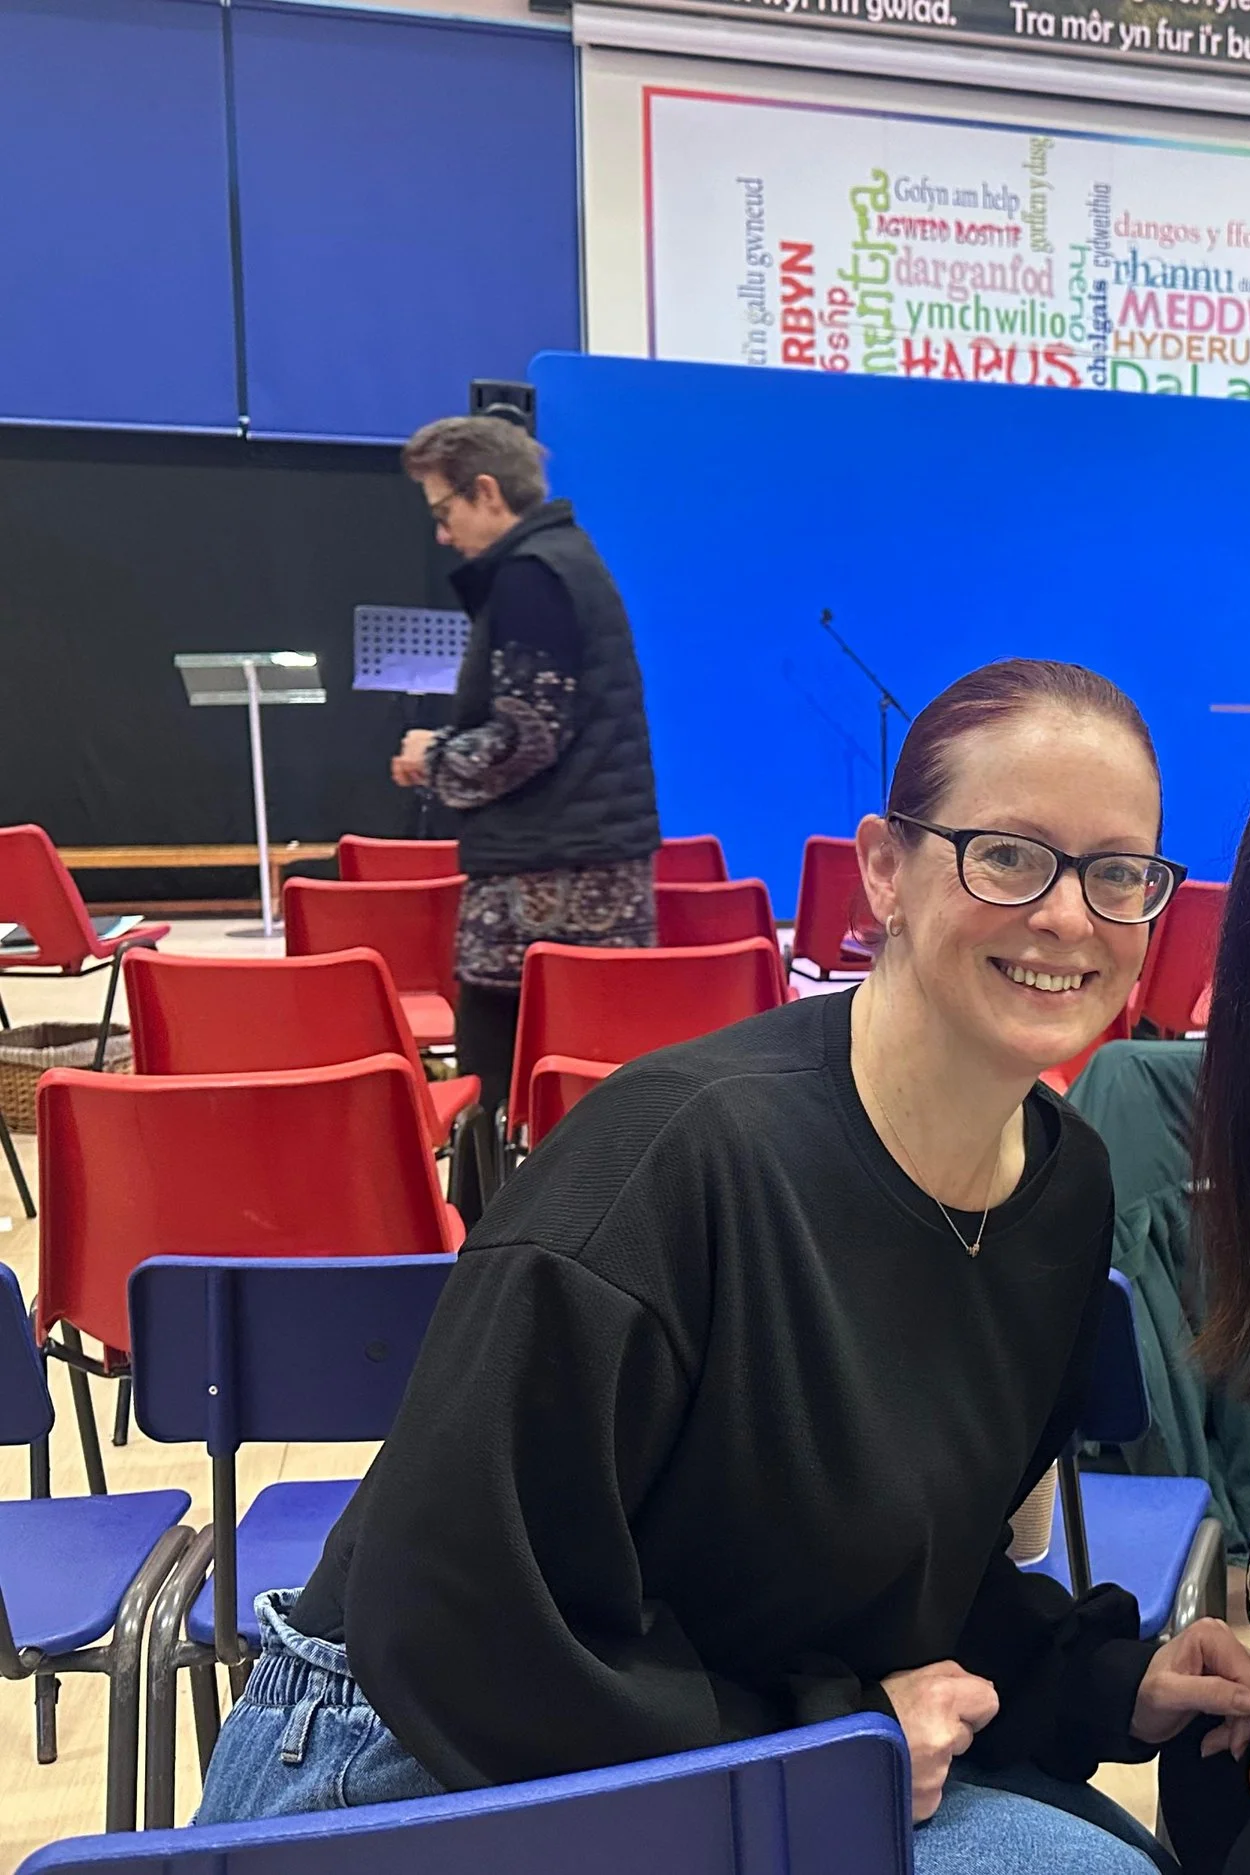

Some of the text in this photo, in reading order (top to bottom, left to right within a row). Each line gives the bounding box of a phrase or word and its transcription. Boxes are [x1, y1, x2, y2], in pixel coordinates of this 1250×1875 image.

[1010, 3, 1056, 37] Tra
[1062, 9, 1113, 43] môr
[1119, 22, 1151, 51] yn
[1156, 18, 1192, 53] fur
[1199, 24, 1223, 56] i'r
[1113, 209, 1201, 249] dangos
[1206, 225, 1221, 252] y
[895, 245, 1056, 304] darganfod
[1113, 246, 1235, 293] rhannu
[906, 291, 1066, 338] ymchwilio
